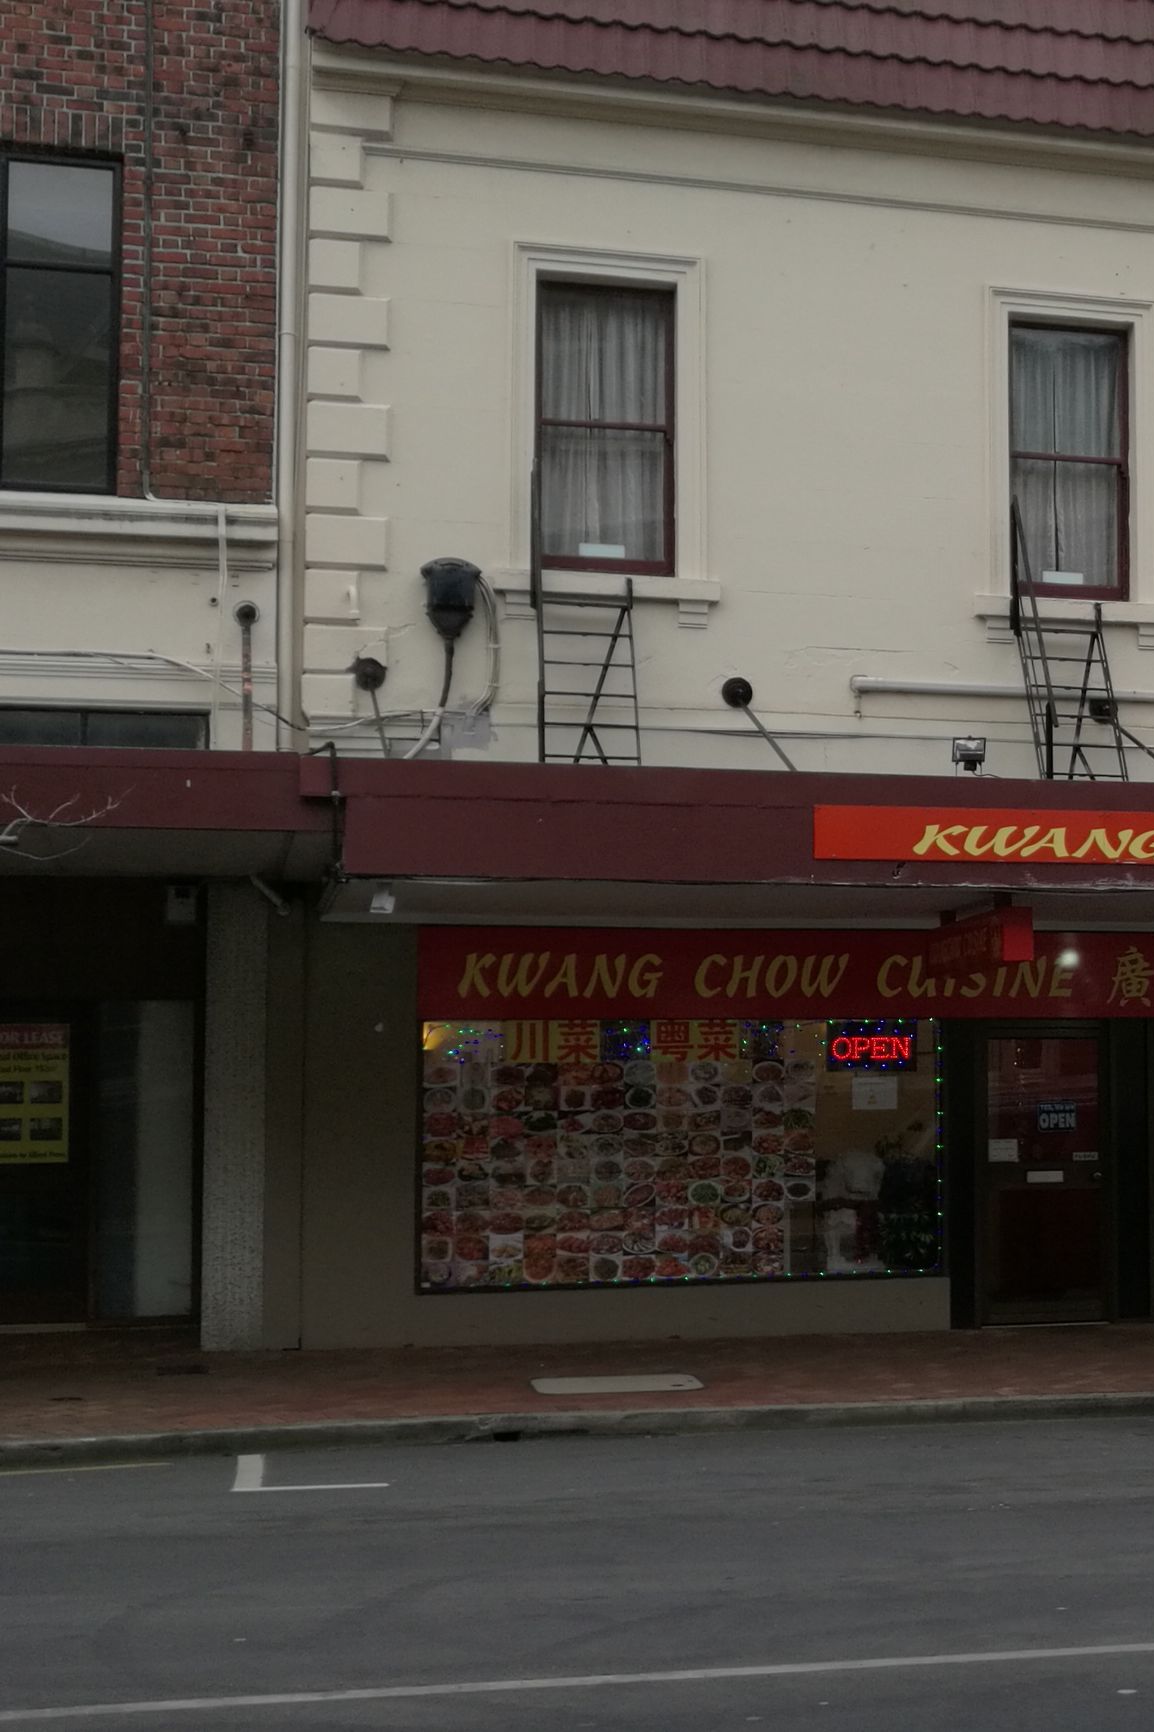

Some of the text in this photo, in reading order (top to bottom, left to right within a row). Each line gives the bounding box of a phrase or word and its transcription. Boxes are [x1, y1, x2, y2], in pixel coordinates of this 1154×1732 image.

[458, 951, 664, 999] KWANG
[694, 953, 850, 998] CHOW
[24, 1031, 64, 1043] LEASE
[511, 1019, 598, 1065] 川菜
[654, 1019, 737, 1063] 粤菜
[831, 1035, 912, 1060] OPEN
[1039, 1112, 1076, 1129] OPEN
